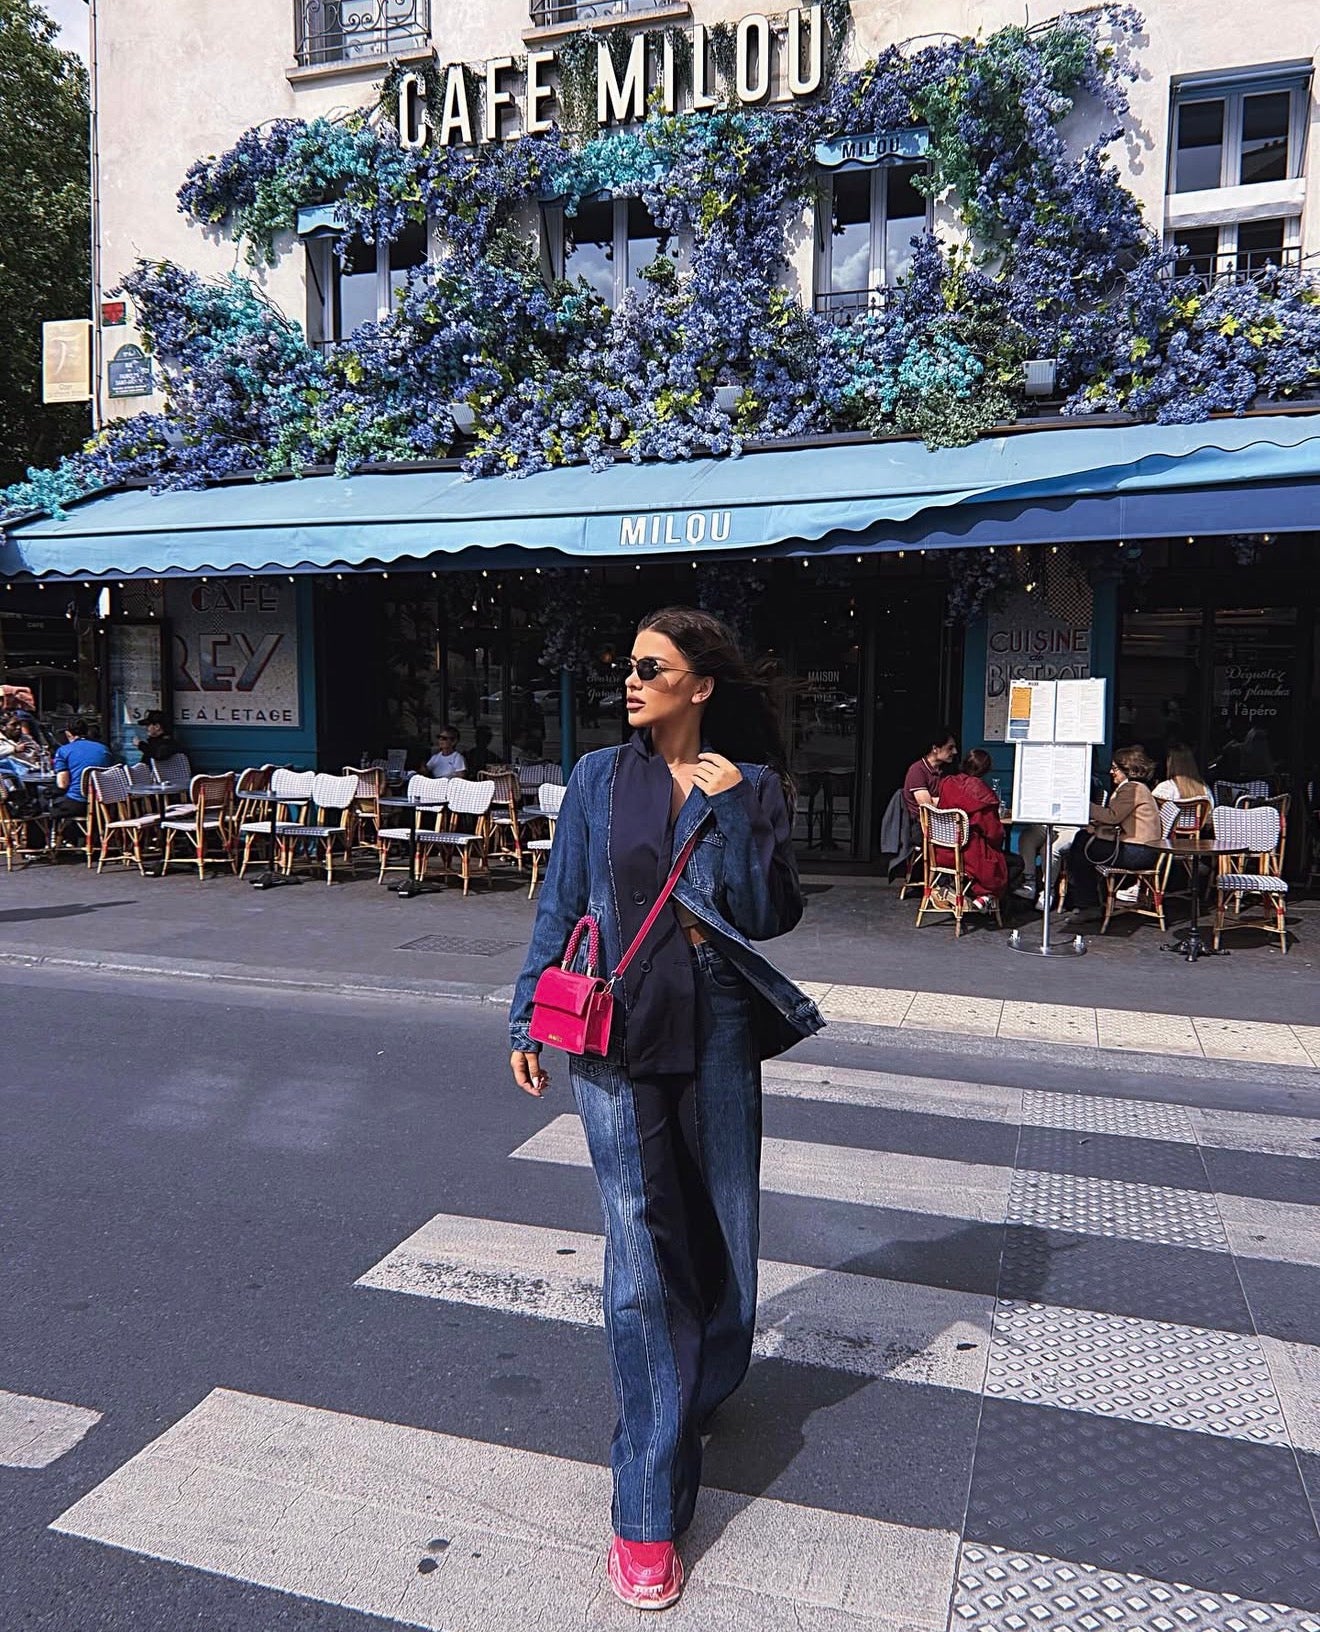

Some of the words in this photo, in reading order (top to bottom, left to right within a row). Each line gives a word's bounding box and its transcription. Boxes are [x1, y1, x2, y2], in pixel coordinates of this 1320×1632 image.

[399, 50, 555, 150] CAFE
[598, 5, 825, 124] MILOU
[842, 137, 900, 158] MILOU
[620, 511, 731, 545] MILOU
[990, 628, 1090, 654] CUISINE
[808, 670, 840, 683] MAISON
